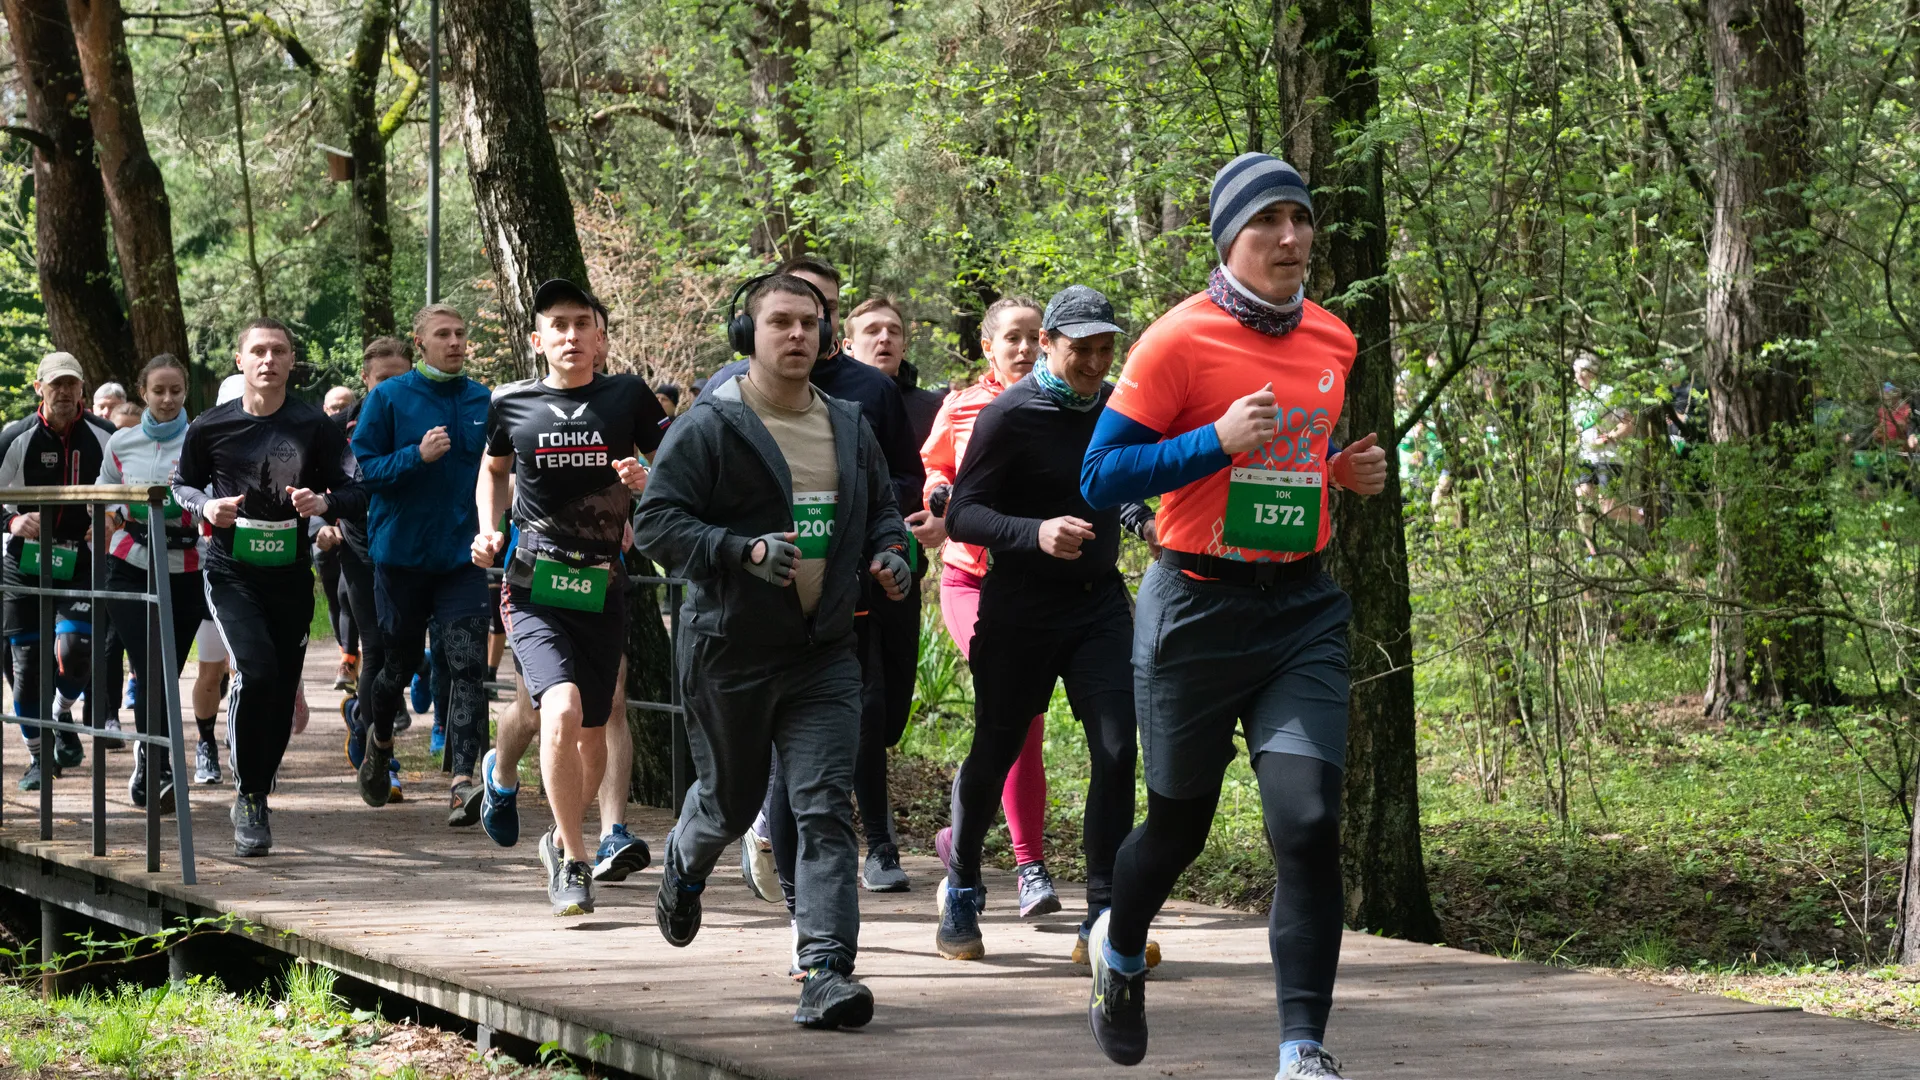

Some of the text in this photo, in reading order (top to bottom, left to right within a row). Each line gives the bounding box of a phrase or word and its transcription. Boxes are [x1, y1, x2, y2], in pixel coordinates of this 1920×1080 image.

[538, 430, 604, 448] ГОНКА
[535, 452, 608, 469] ГЕРОЕВ
[1275, 490, 1292, 499] 10K
[807, 507, 822, 515] 10K
[1253, 503, 1305, 526] 1372
[249, 539, 285, 552] 1302
[568, 567, 581, 575] 10K
[551, 574, 592, 594] 1348
